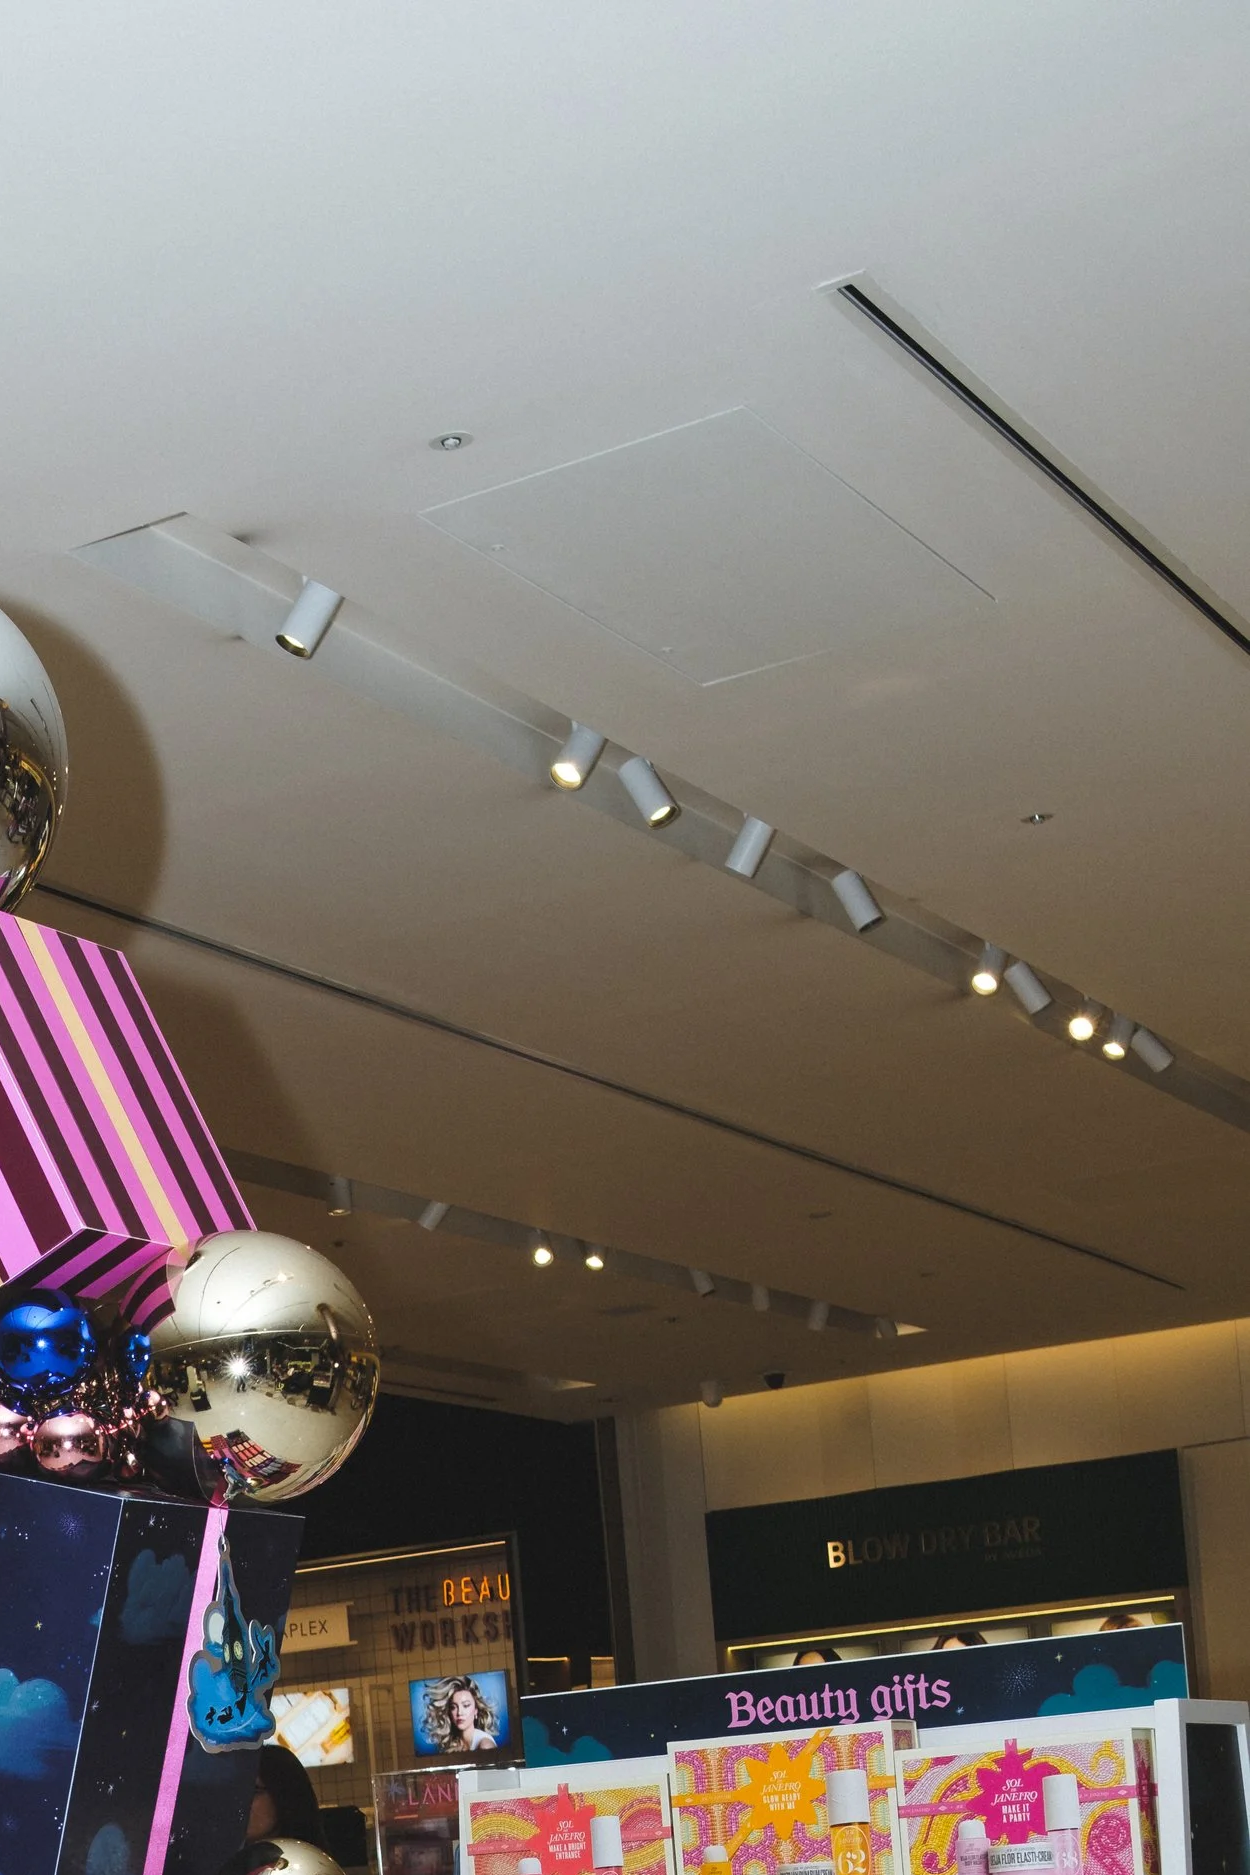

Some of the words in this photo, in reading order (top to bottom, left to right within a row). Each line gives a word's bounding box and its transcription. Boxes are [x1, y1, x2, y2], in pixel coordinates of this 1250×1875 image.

[827, 1532, 910, 1569] BLOW
[921, 1524, 974, 1556] DRY
[983, 1516, 1041, 1548] BAR
[391, 1585, 437, 1615] THE
[725, 1683, 860, 1728] Beauty
[871, 1673, 951, 1721] gifts
[770, 1770, 787, 1782] SOL
[760, 1781, 801, 1794] JANEIRO
[1002, 1778, 1023, 1791] SOL
[991, 1790, 1038, 1806] JANEIRO
[1001, 1805, 1018, 1814] MAKE
[1020, 1803, 1030, 1812] IT
[1003, 1814, 1007, 1823] A
[1009, 1811, 1030, 1822] PARTY
[556, 1820, 574, 1831] SOL
[549, 1831, 585, 1842] JANEIRO
[838, 1849, 866, 1874] 62
